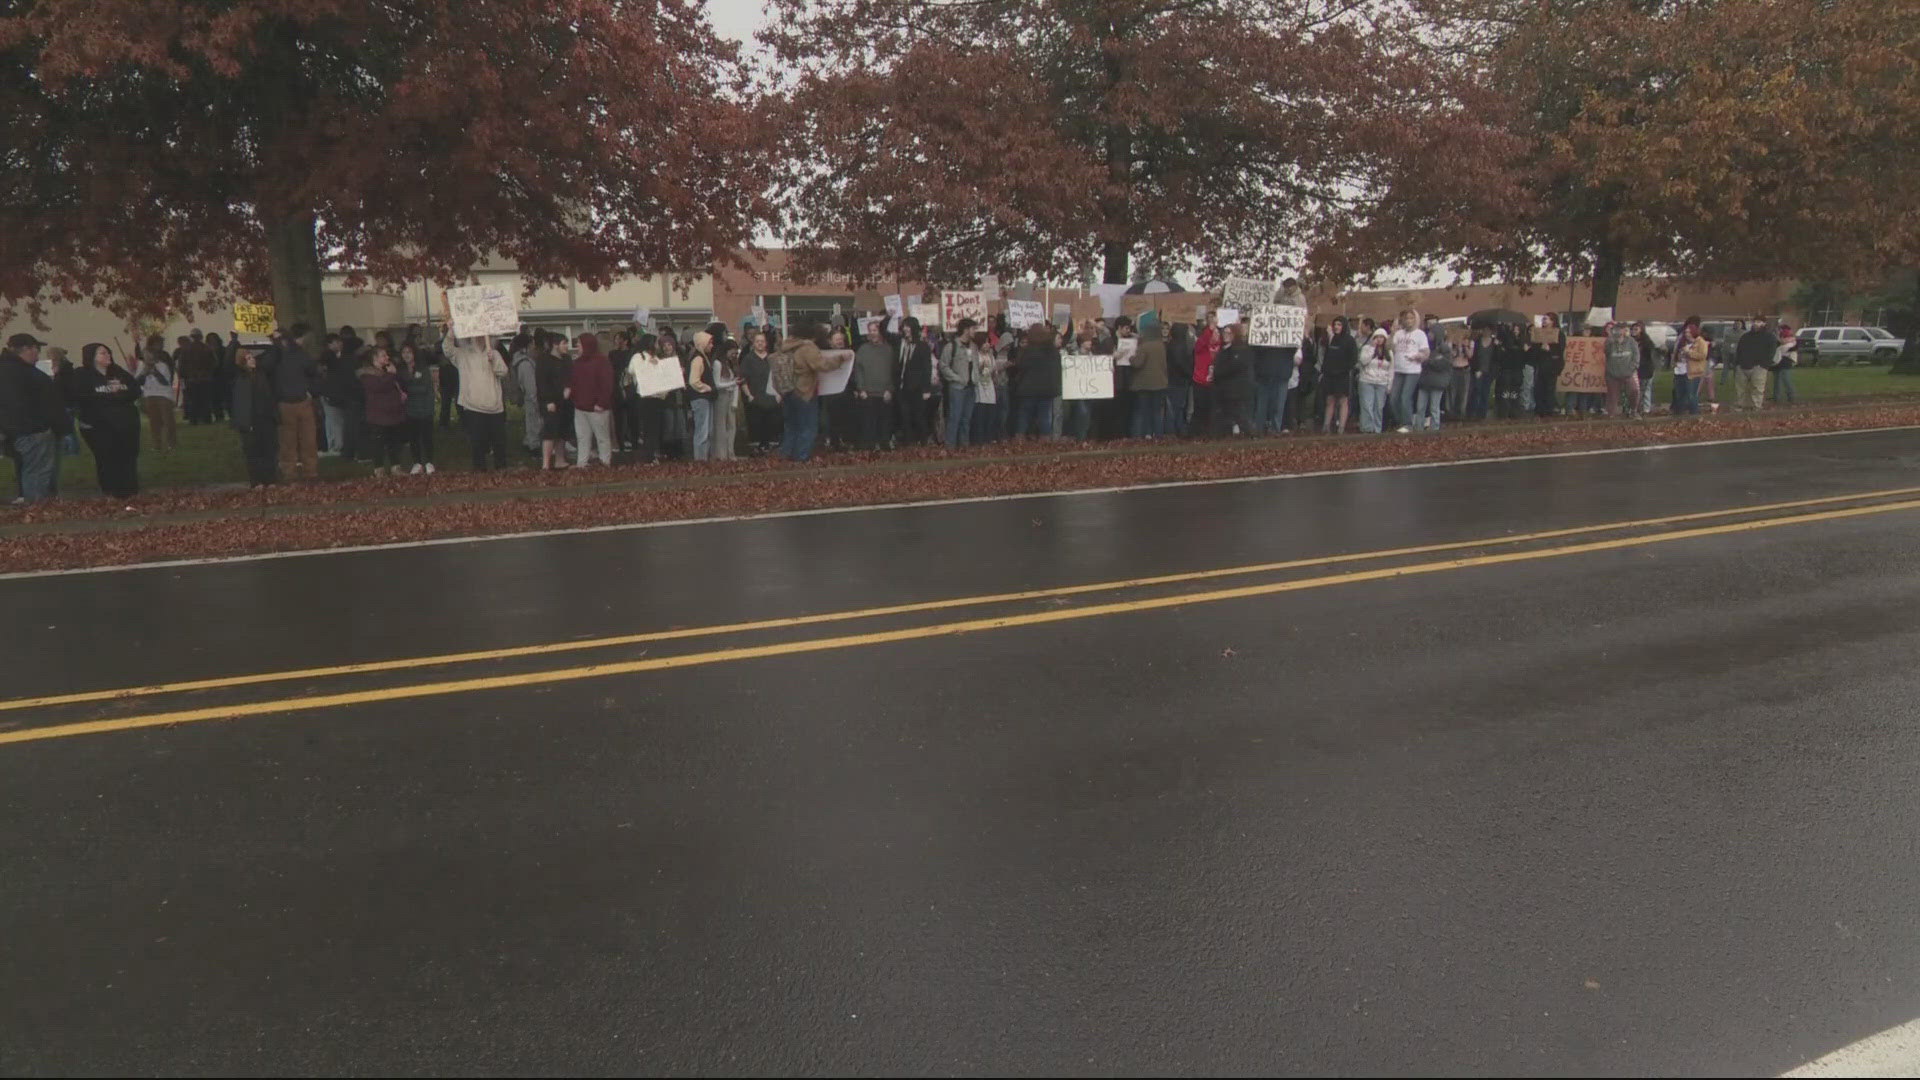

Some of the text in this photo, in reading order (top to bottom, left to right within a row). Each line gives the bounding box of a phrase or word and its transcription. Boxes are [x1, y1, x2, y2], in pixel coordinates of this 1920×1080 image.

[945, 293, 954, 307] I
[255, 305, 273, 316] YOU
[244, 322, 269, 333] YET?
[1254, 315, 1304, 329] SUPPORTS
[1078, 377, 1100, 396] US
